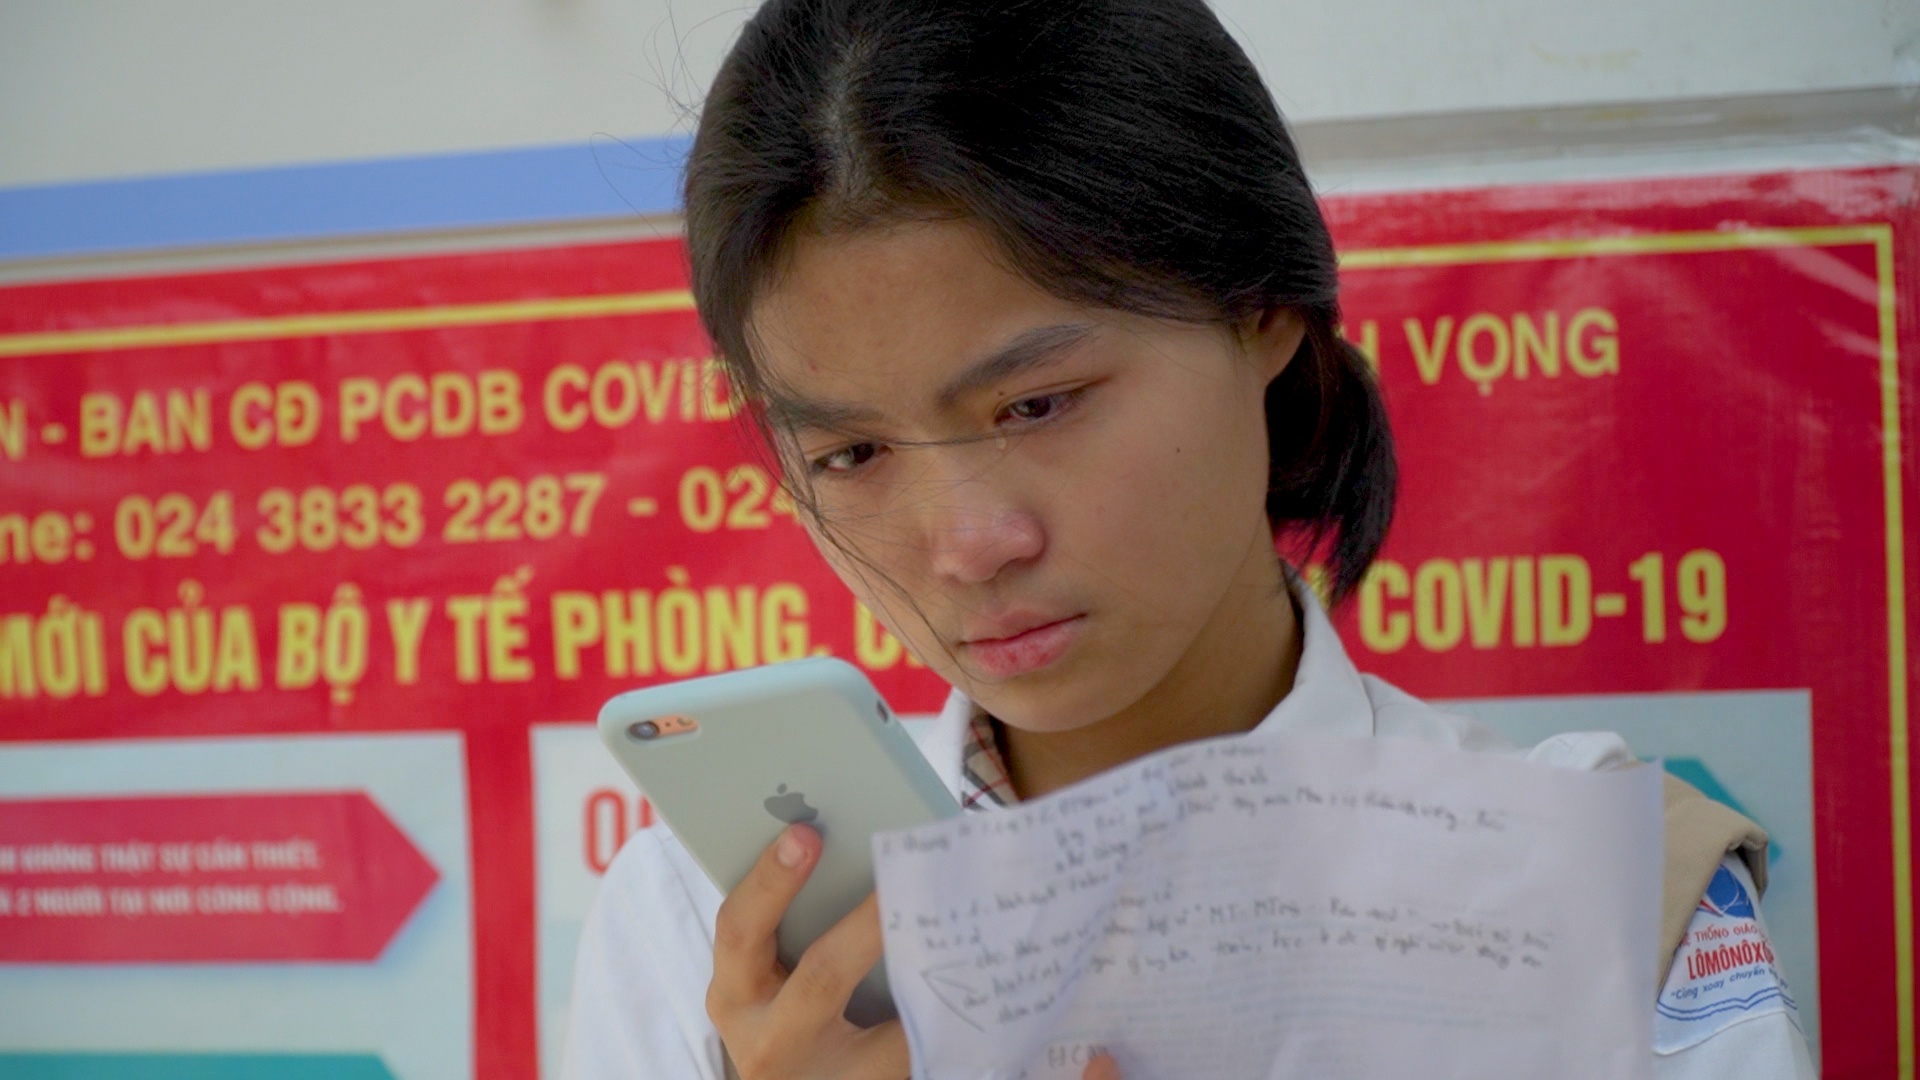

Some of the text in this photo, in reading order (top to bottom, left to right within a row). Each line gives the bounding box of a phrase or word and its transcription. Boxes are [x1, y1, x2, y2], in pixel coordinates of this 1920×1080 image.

[80, 389, 211, 457] BAN
[230, 381, 321, 449] CĐ
[339, 369, 524, 442] PCDB
[543, 356, 746, 431] COVID
[1404, 306, 1620, 396] VỌNG
[115, 490, 235, 559] 024
[257, 482, 424, 553] 3833
[443, 471, 607, 543] 2287
[122, 579, 261, 694] CỦA
[276, 583, 369, 705] BỘ
[386, 598, 431, 684] Y
[446, 565, 533, 682] TẾ
[1358, 548, 1728, 654] COVID-19
[1703, 978, 1725, 993] xoay
